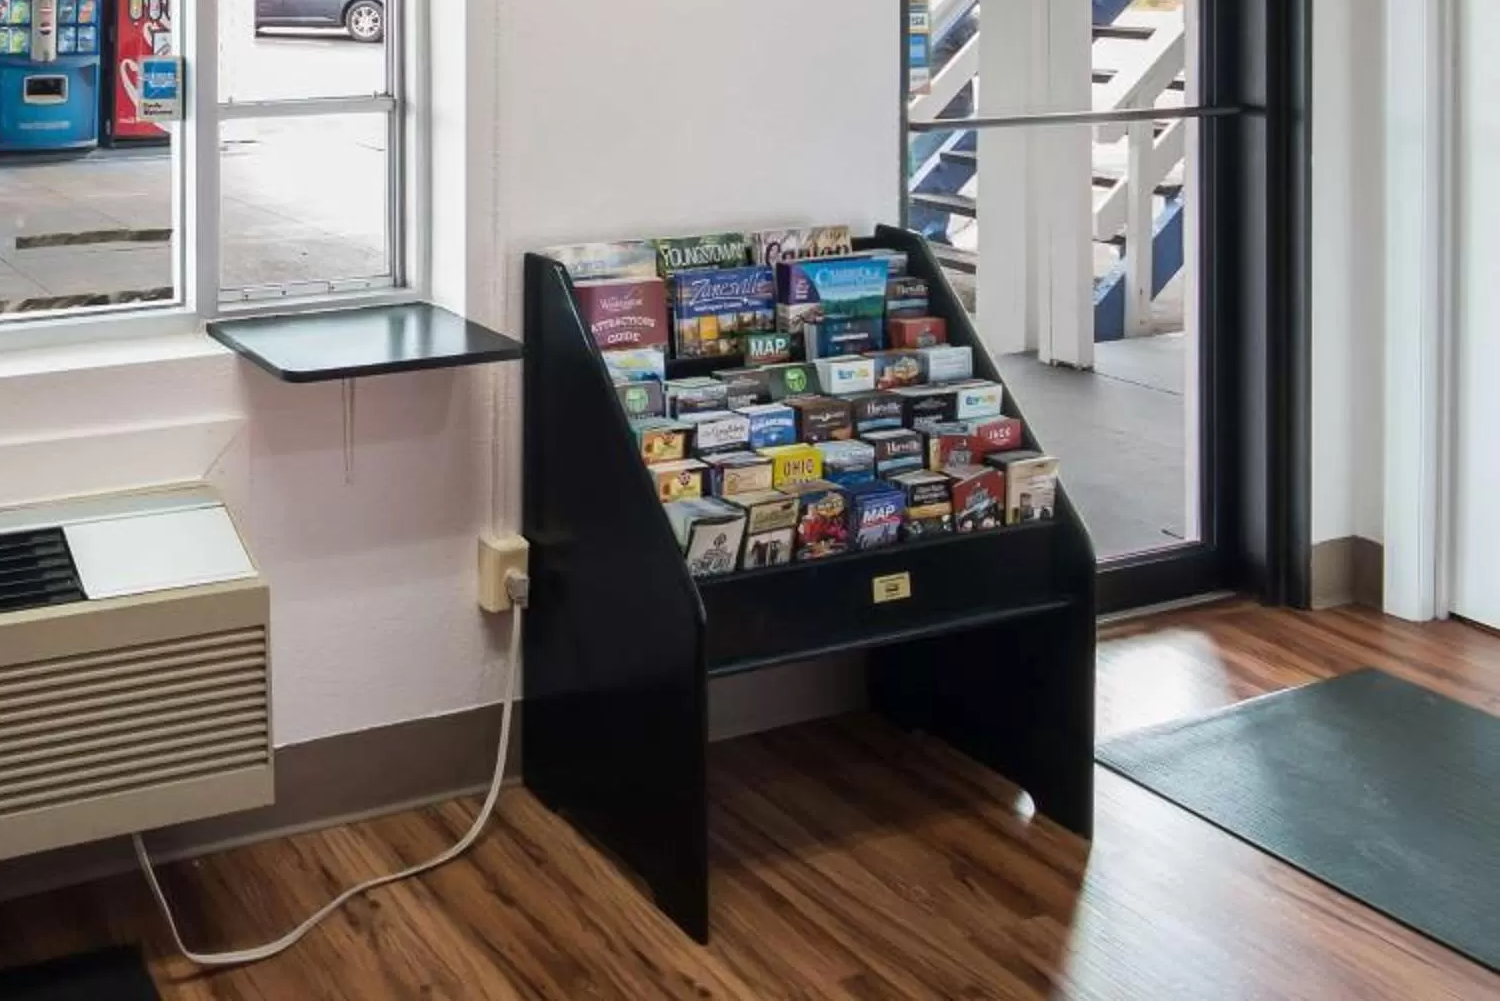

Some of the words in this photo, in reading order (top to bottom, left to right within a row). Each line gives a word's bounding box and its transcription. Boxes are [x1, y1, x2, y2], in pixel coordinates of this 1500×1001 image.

[662, 241, 745, 267] YOUNGSTOWN
[750, 339, 787, 356] MAP
[783, 458, 814, 476] OHIO
[863, 505, 896, 523] MAP
